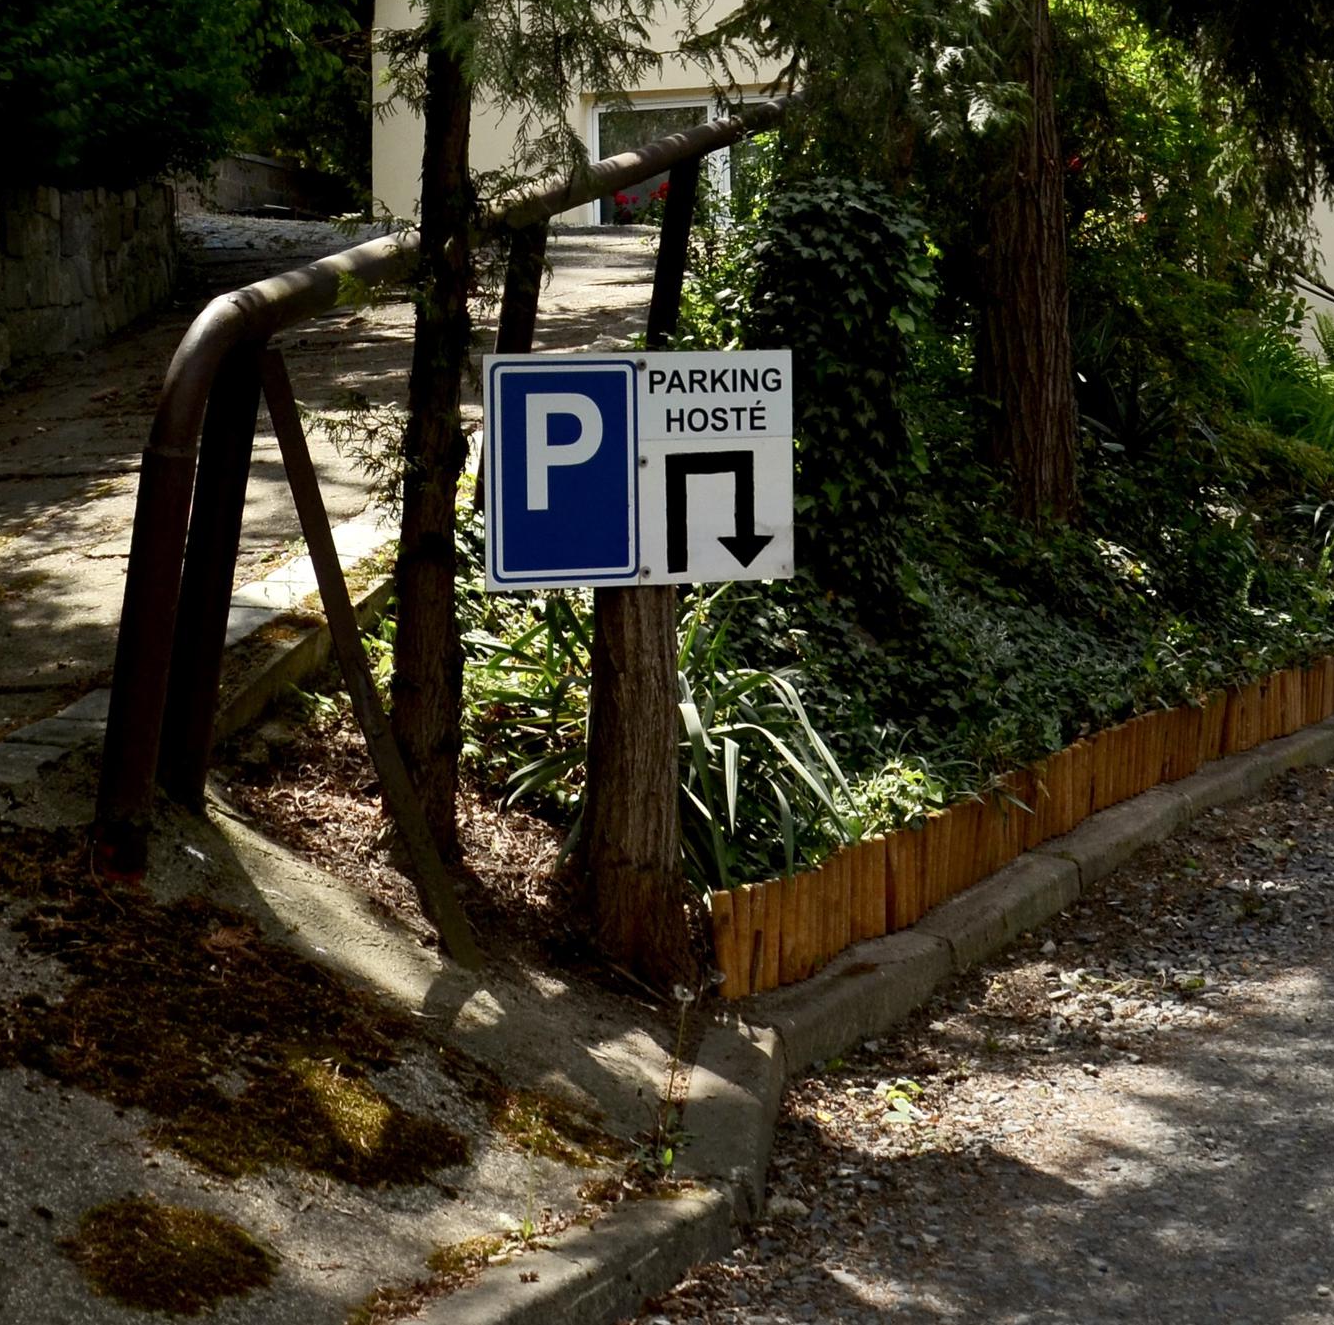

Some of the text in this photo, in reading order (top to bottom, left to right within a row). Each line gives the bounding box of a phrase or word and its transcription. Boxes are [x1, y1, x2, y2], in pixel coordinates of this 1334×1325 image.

[648, 368, 782, 394] PARKING
[666, 400, 767, 432] HOSTÉ
[525, 392, 603, 511] P
